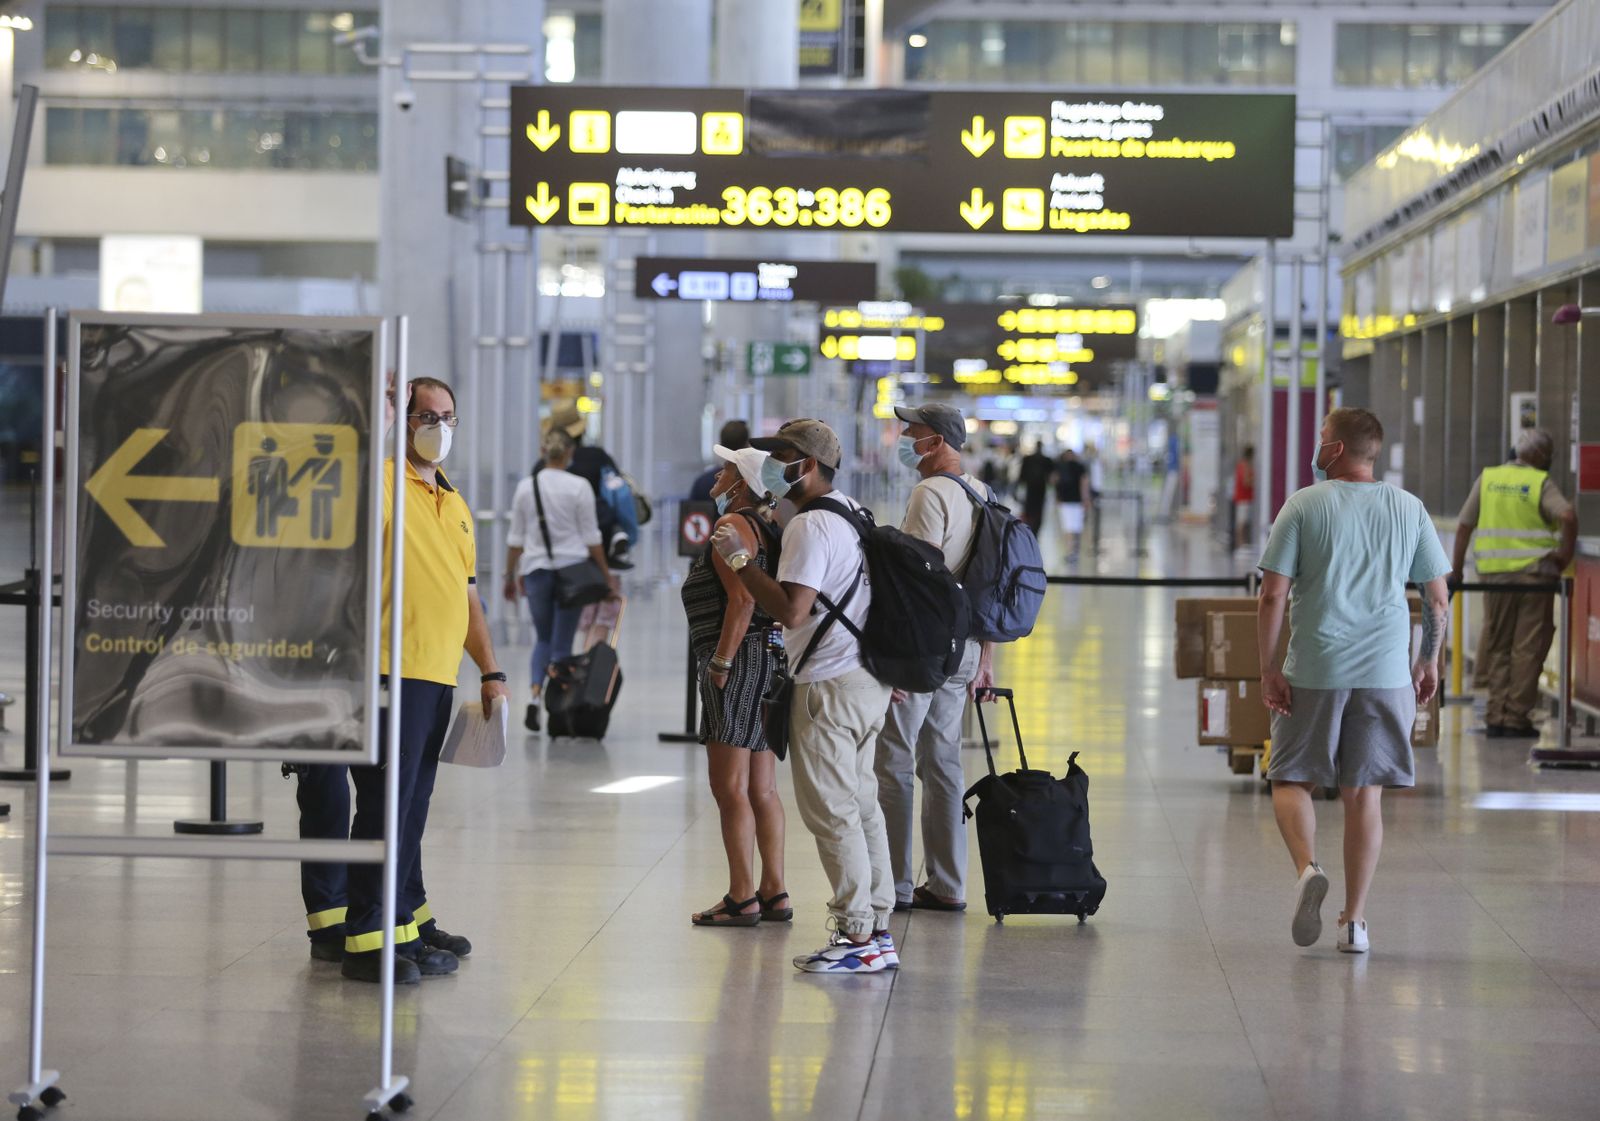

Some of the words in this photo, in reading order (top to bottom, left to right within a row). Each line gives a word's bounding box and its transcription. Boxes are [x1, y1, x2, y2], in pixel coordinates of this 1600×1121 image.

[720, 185, 799, 226] 363
[813, 187, 892, 228] 386
[87, 599, 174, 625] Security
[180, 604, 254, 623] control
[85, 633, 165, 655] Control
[171, 637, 199, 656] de
[207, 638, 313, 661] seguridad
